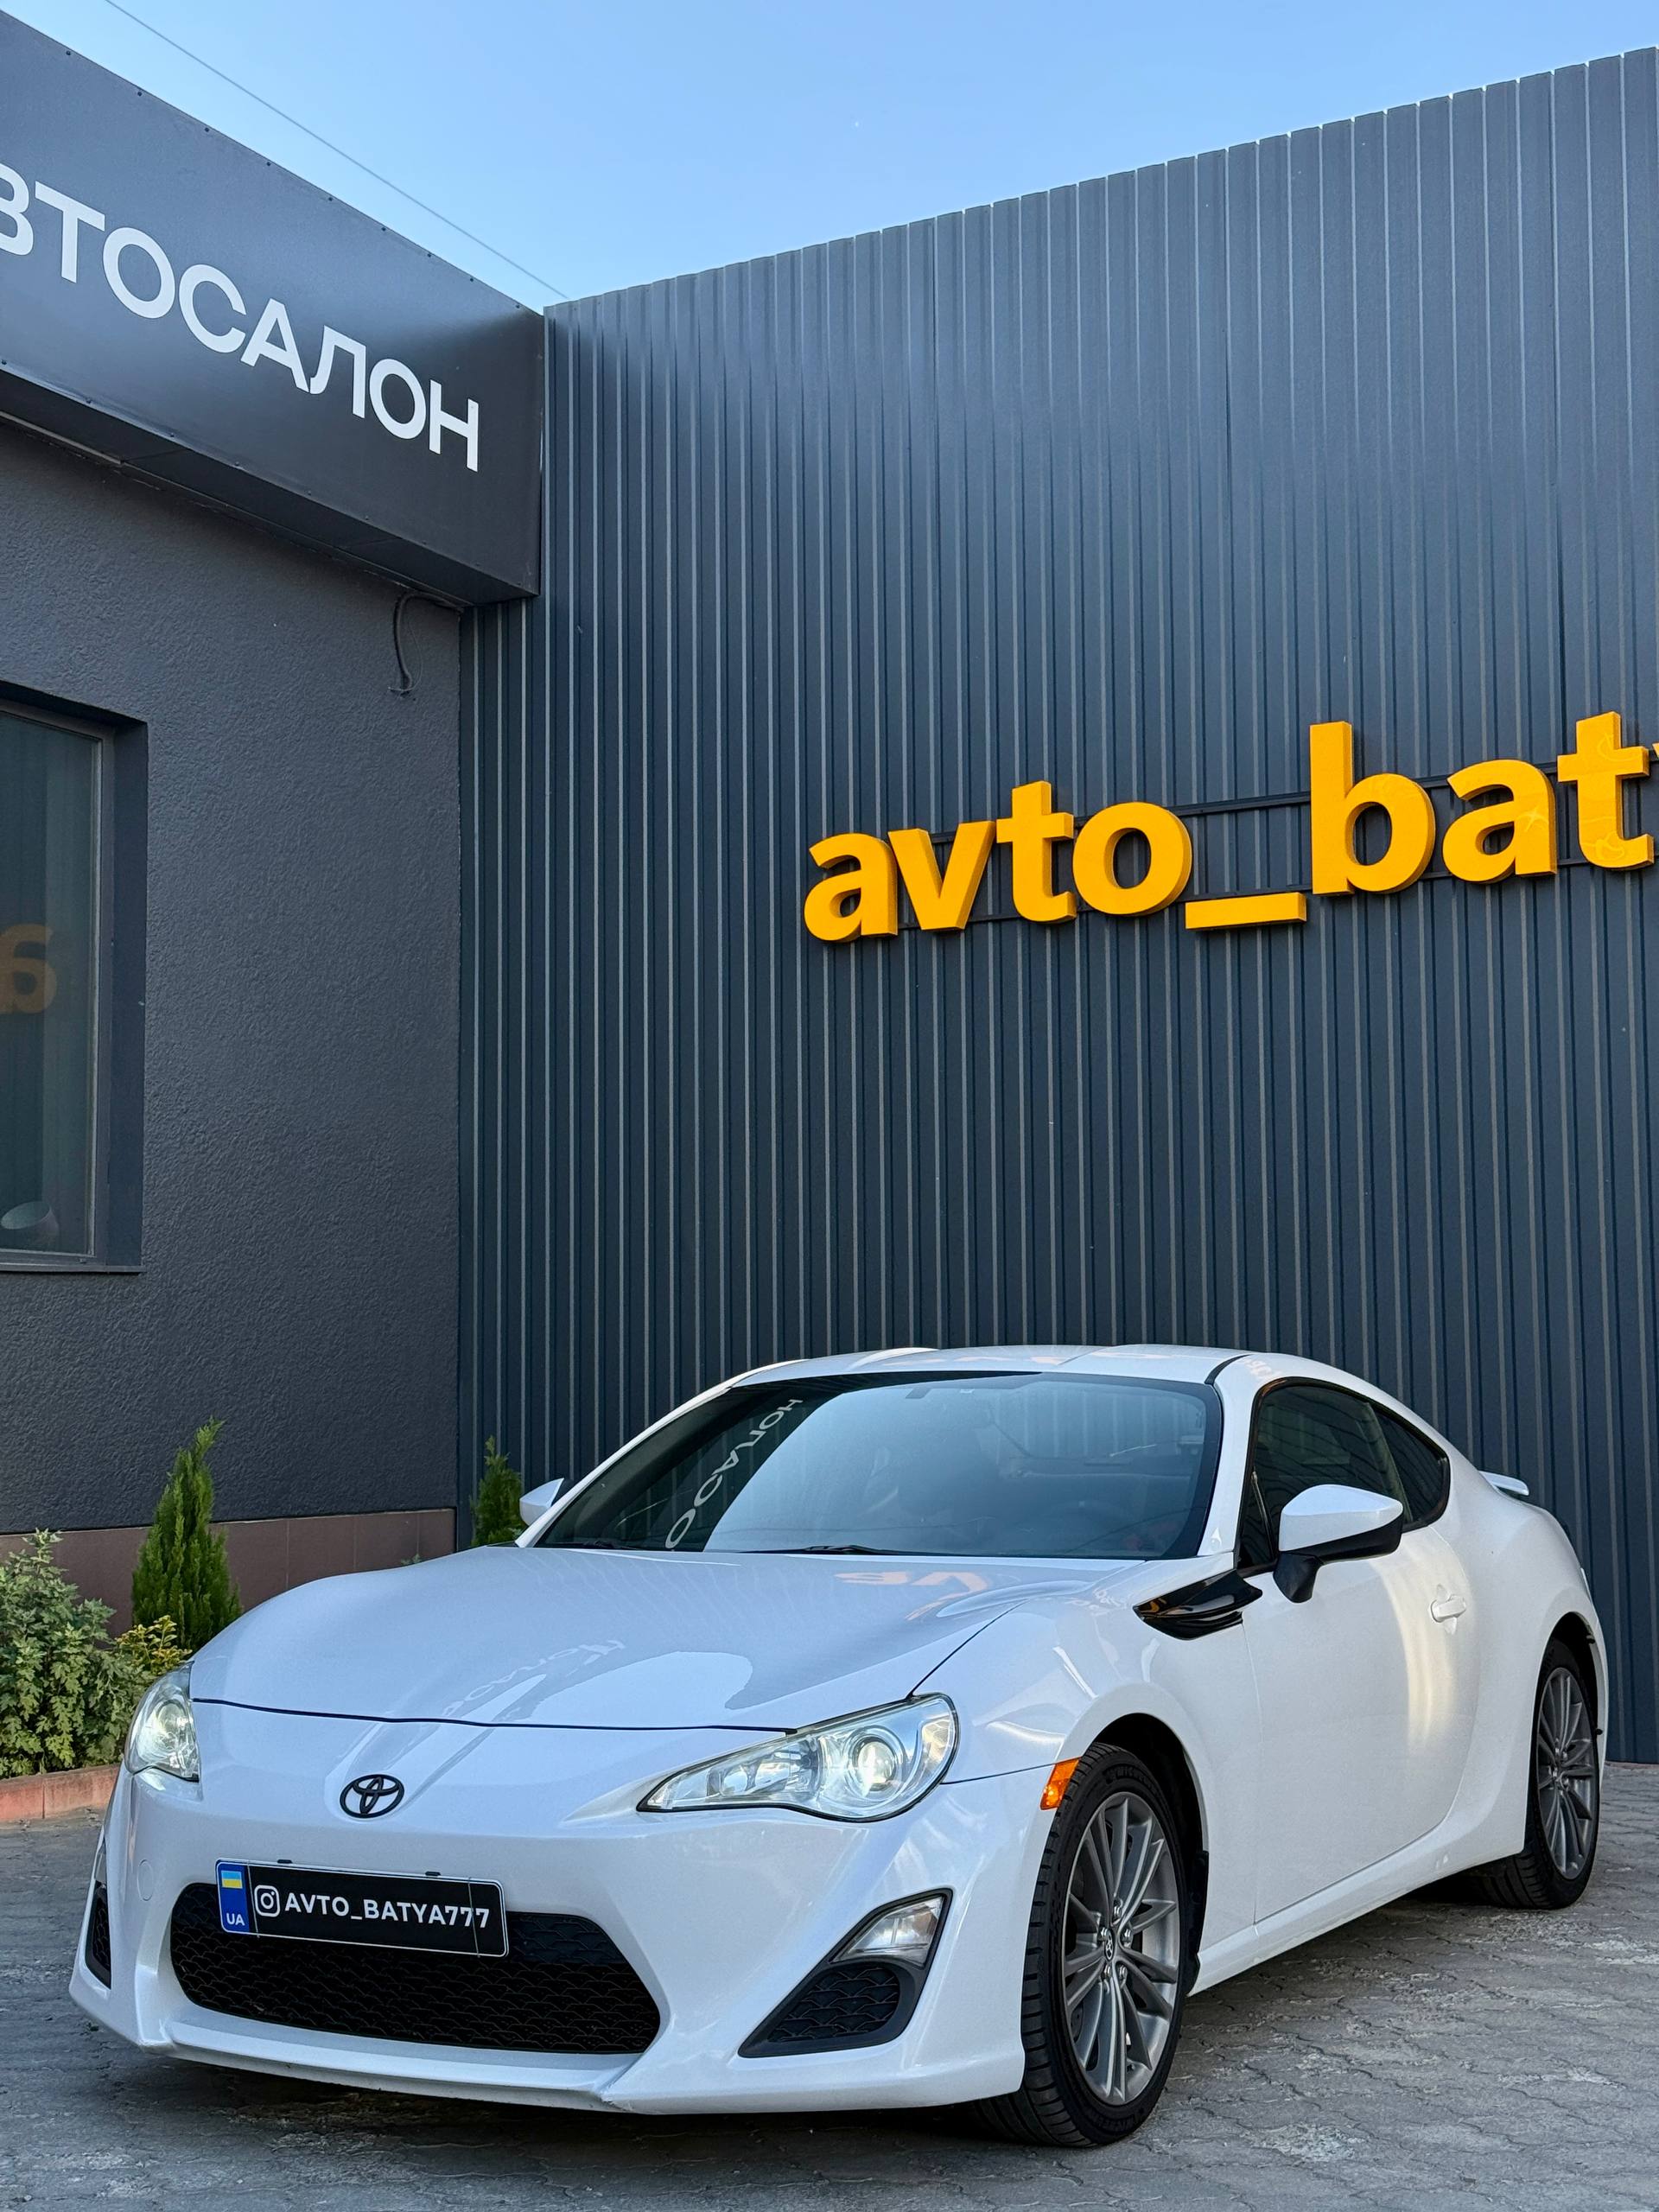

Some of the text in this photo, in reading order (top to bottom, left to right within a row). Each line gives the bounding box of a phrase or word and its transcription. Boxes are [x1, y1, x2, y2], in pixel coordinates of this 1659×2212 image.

[804, 710, 1659, 943] avto_bat
[226, 1912, 246, 1926] UA
[284, 1892, 491, 1929] AVTO_BATYA777
